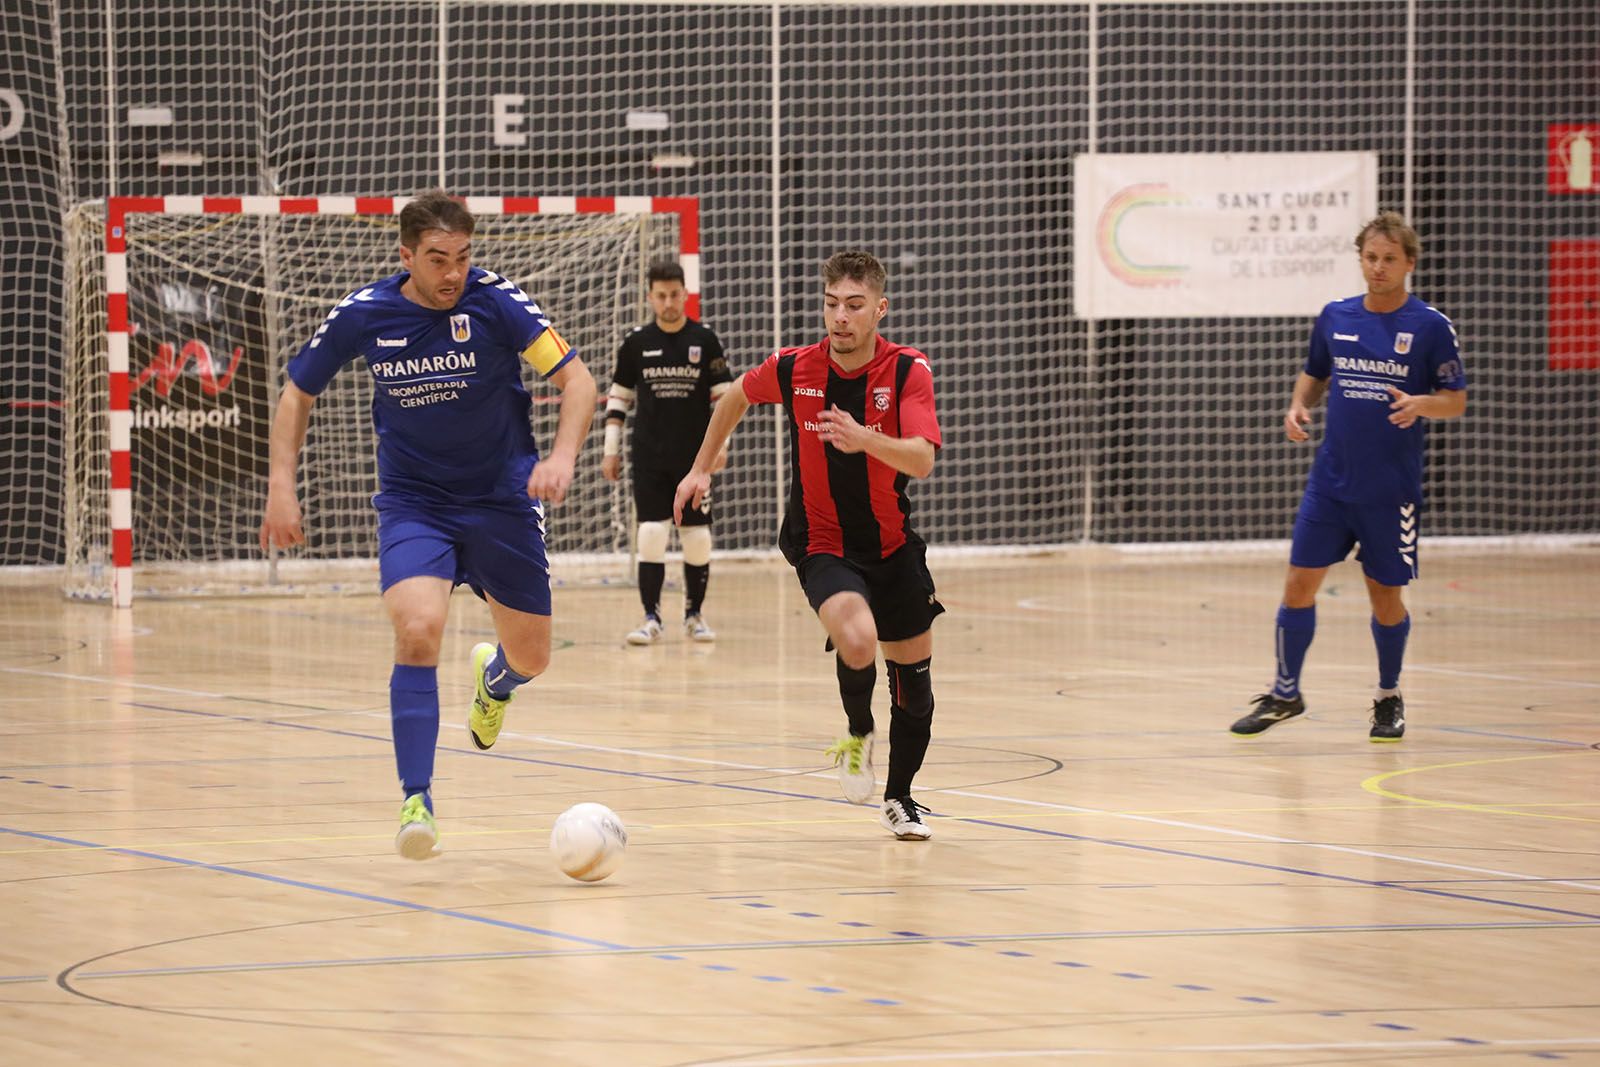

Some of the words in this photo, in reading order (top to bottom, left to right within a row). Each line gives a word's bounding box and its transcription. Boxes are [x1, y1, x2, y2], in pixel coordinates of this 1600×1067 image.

[493, 94, 526, 146] E
[1217, 191, 1271, 210] SANT
[1282, 190, 1350, 209] CUGAT
[1247, 213, 1318, 232] 2018
[1211, 236, 1268, 256] CIUTAT
[400, 390, 459, 408] CIENTÍFICA
[130, 404, 241, 434] inksport
